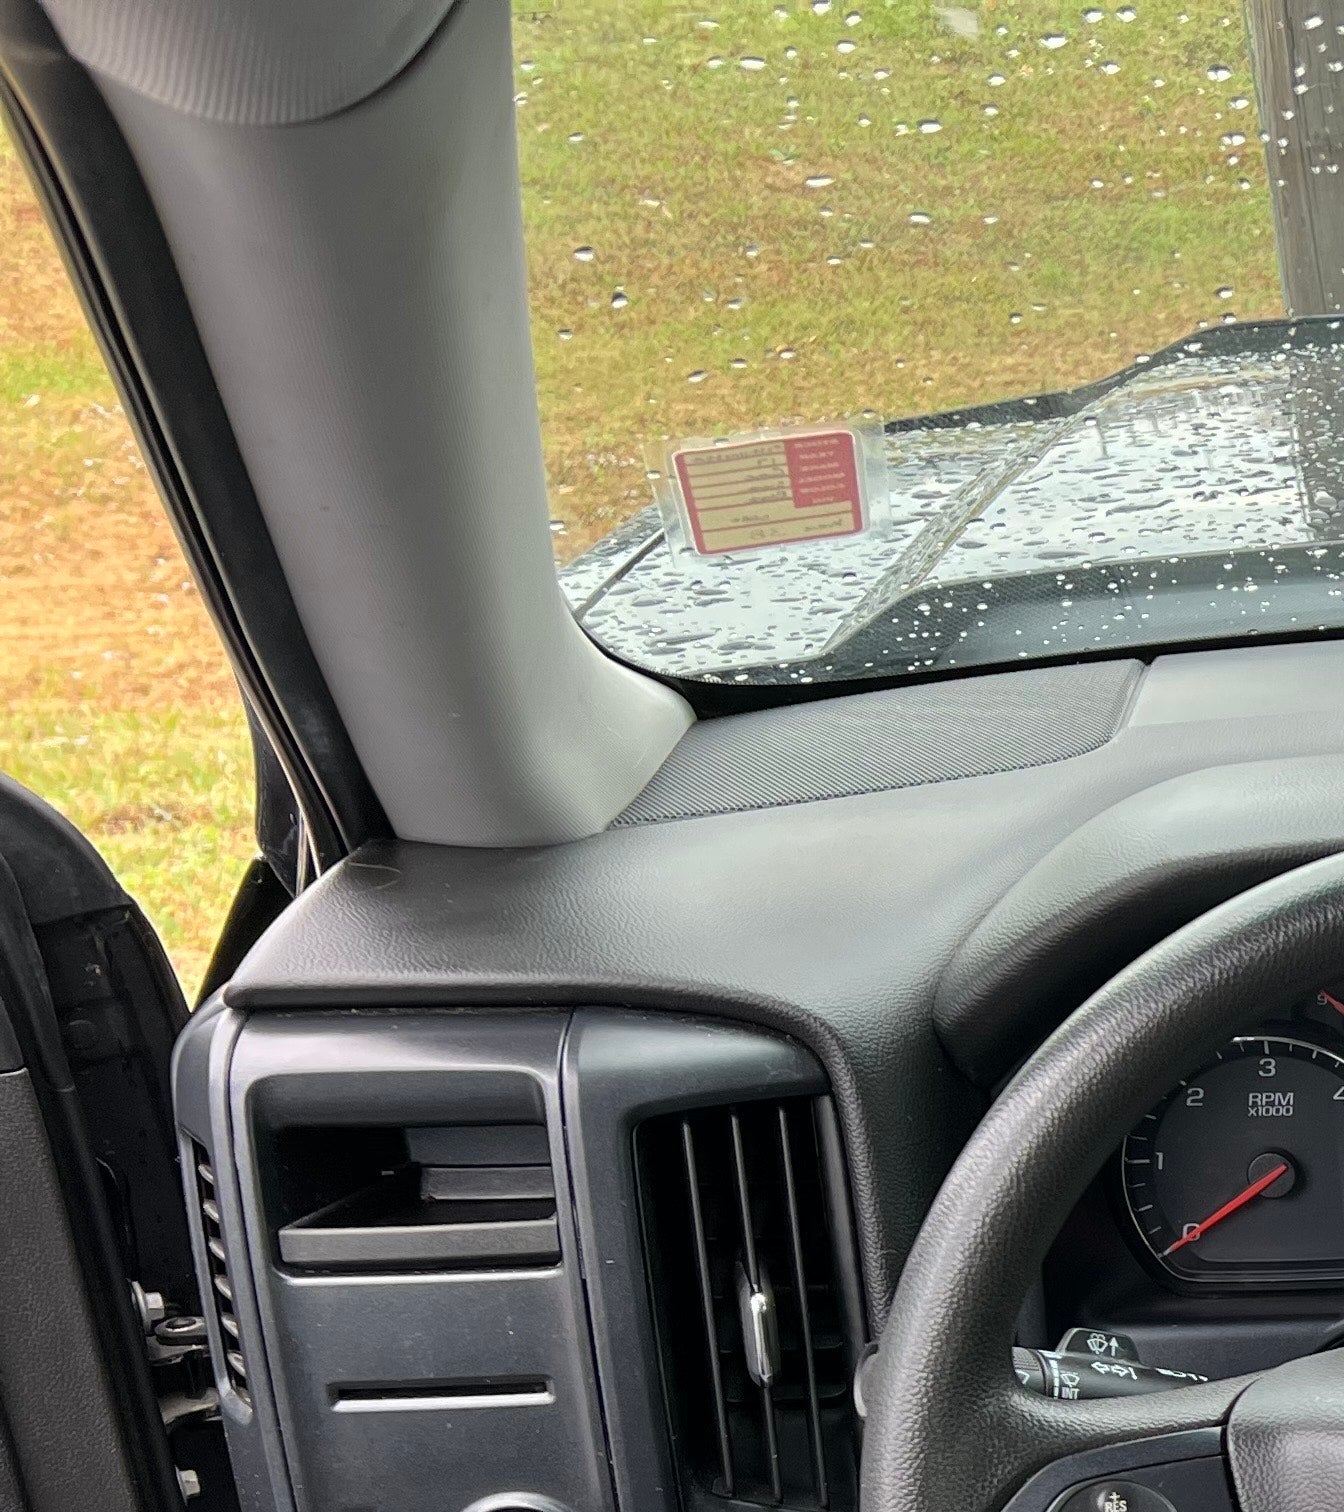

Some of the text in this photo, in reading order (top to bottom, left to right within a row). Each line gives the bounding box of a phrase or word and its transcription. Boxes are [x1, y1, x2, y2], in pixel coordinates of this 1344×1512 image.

[1258, 1057, 1277, 1077] 3
[1185, 1087, 1204, 1107] 2
[1248, 1092, 1294, 1106] RPM
[1155, 1152, 1163, 1170] 1
[1061, 1386, 1080, 1400] INT
